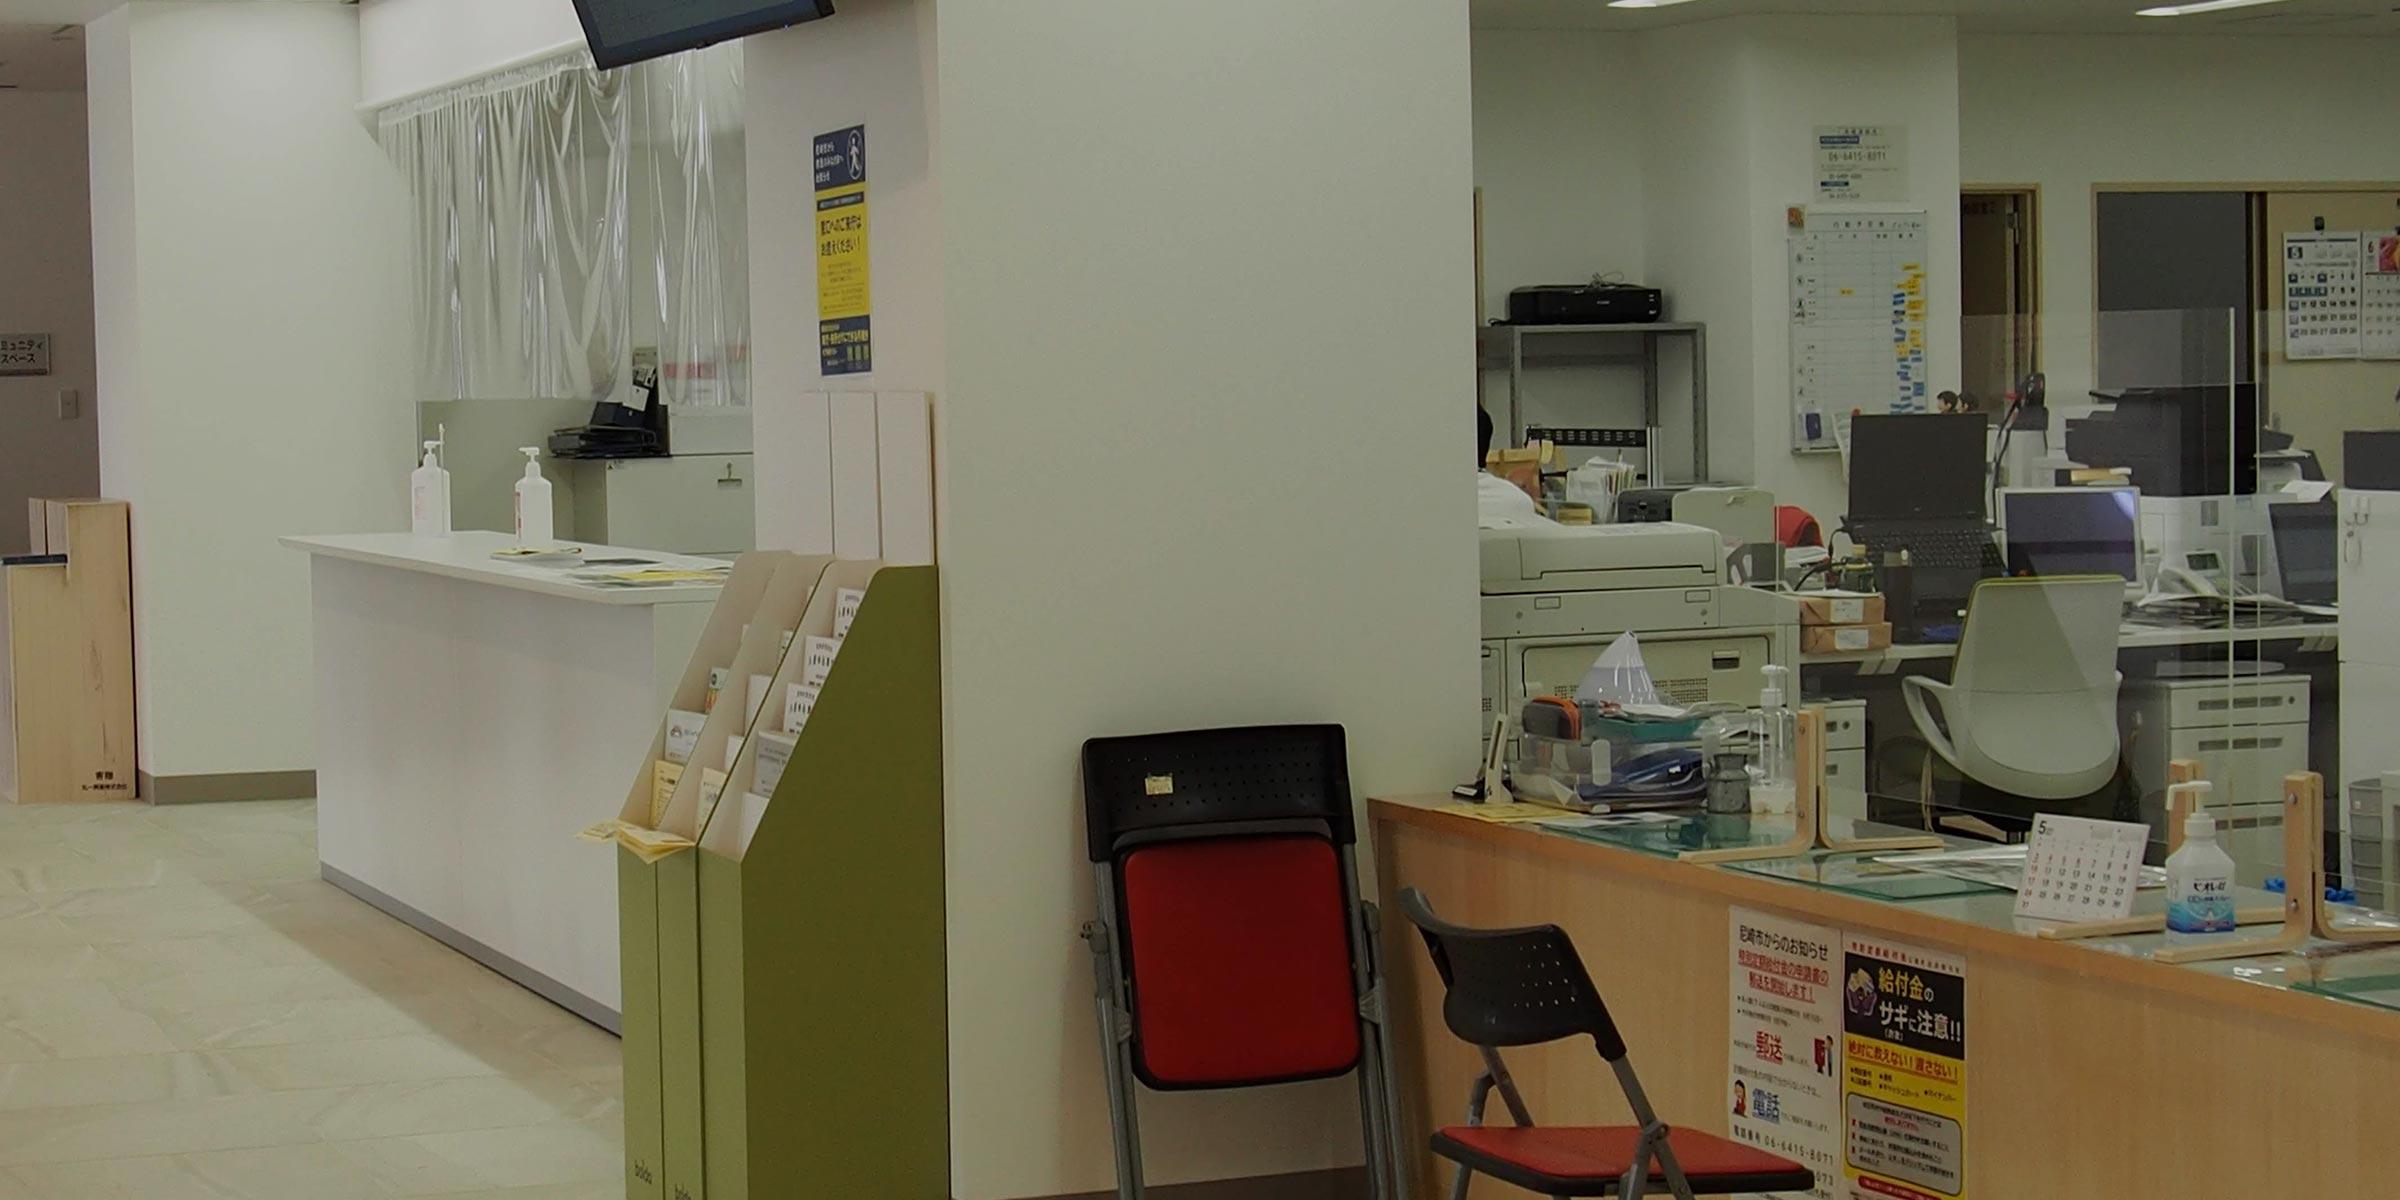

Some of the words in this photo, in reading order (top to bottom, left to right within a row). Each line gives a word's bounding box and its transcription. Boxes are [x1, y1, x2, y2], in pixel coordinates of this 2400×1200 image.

[2368, 241, 2374, 253] 6
[1, 353, 36, 363] スペース
[2038, 821, 2047, 834] 5
[1739, 925, 1829, 961] 尼崎市からのお知らせ
[1878, 966, 1935, 1003] 給付金の
[1879, 1000, 1961, 1042] サギに注意!!
[1756, 1030, 1783, 1061] 郵送
[1752, 1088, 1779, 1121] 電話
[1764, 1135, 1834, 1166] 06-6415-8071
